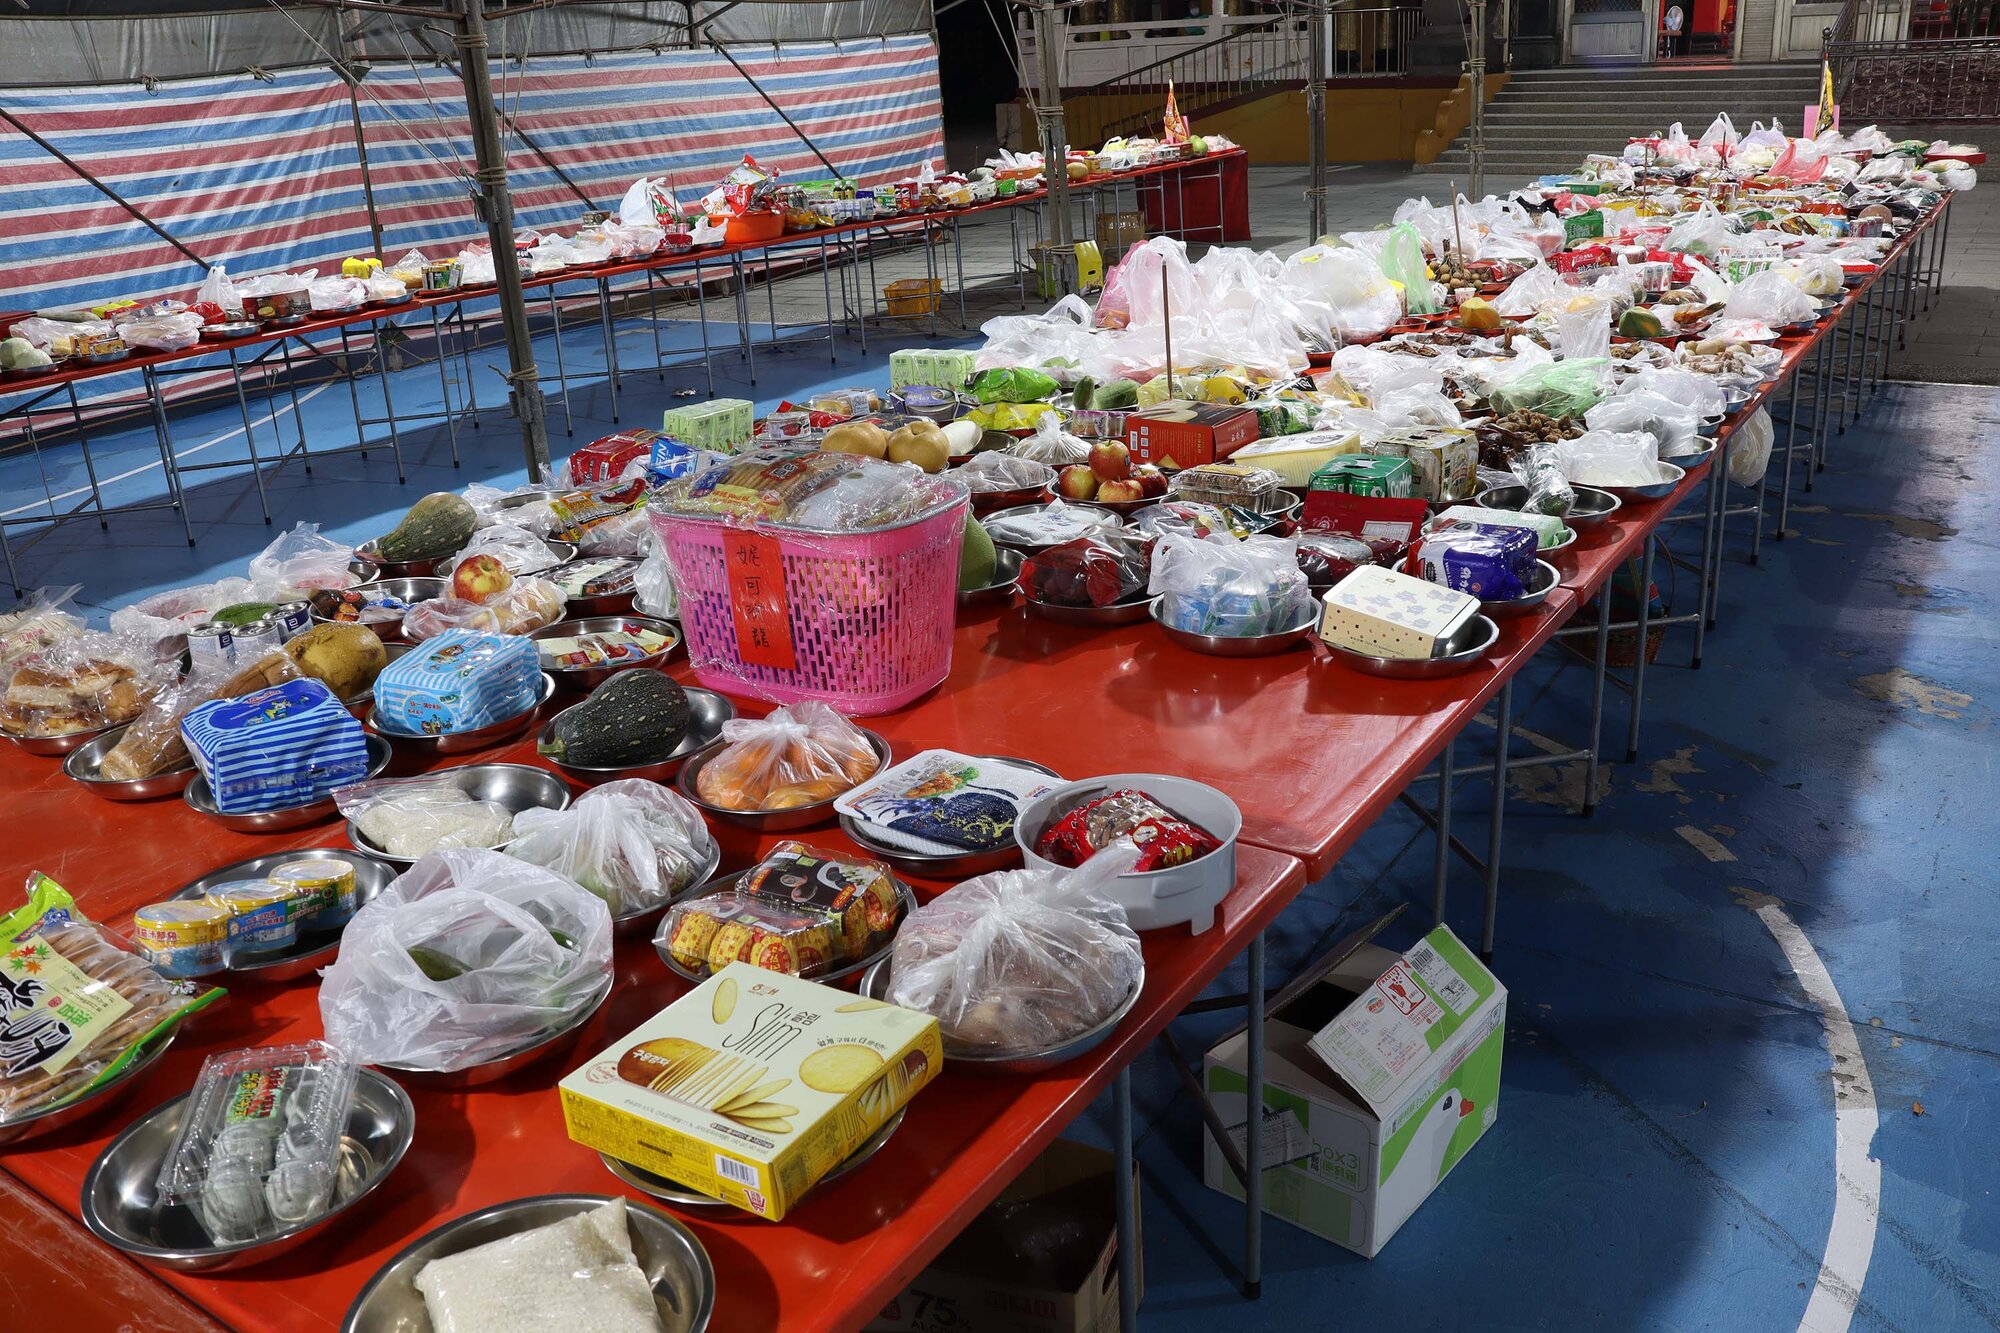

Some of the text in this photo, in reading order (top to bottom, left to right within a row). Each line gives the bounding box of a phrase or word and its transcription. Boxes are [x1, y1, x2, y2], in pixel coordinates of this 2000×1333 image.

[791, 1011, 821, 1026] 슬림
[722, 1003, 802, 1061] Slim
[631, 1048, 671, 1066] 구운감자
